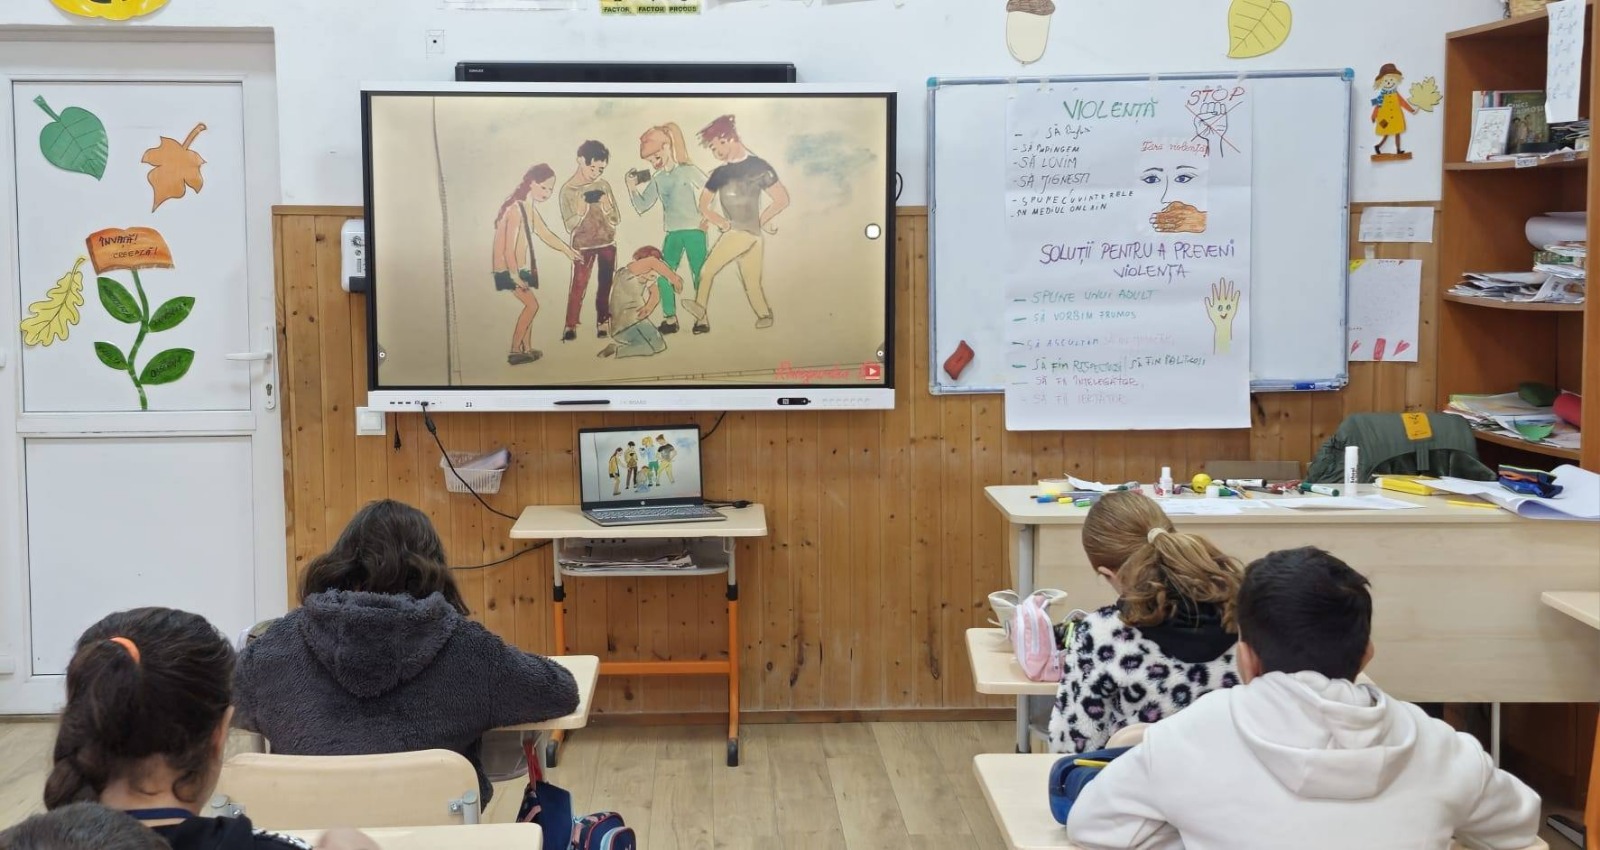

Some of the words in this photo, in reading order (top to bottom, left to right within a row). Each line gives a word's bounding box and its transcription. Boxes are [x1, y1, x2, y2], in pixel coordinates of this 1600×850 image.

[1187, 86, 1245, 106] STOP
[1101, 242, 1153, 260] PENTRU
[1156, 243, 1166, 258] A
[1031, 290, 1076, 304] SPUNE
[1118, 289, 1157, 301] ADULT
[1054, 311, 1093, 321] VORBIM
[1099, 311, 1137, 319] FRUMOS
